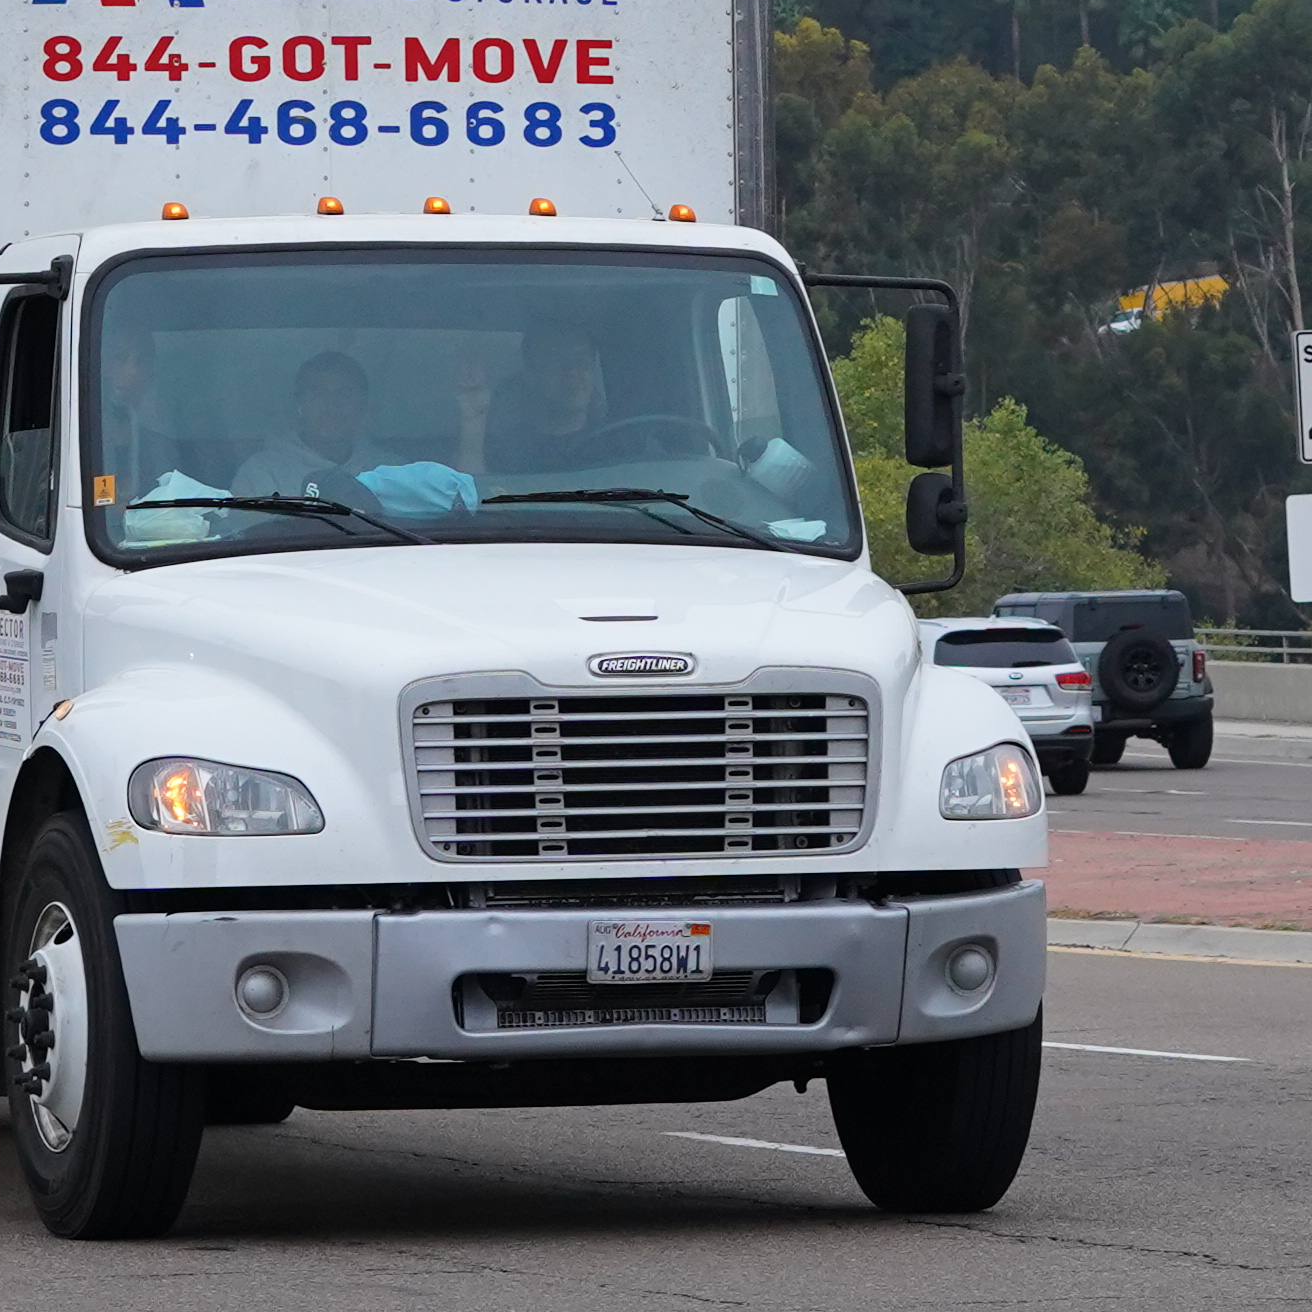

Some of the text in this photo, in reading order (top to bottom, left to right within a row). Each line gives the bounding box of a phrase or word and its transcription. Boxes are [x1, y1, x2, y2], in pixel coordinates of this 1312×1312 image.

[41, 34, 614, 86] 844-GOT-MOVE
[39, 98, 617, 148] 844-468-6683
[601, 658, 685, 671] FREIGHTLINER
[615, 923, 691, 943] California
[596, 944, 704, 975] 41858W1
